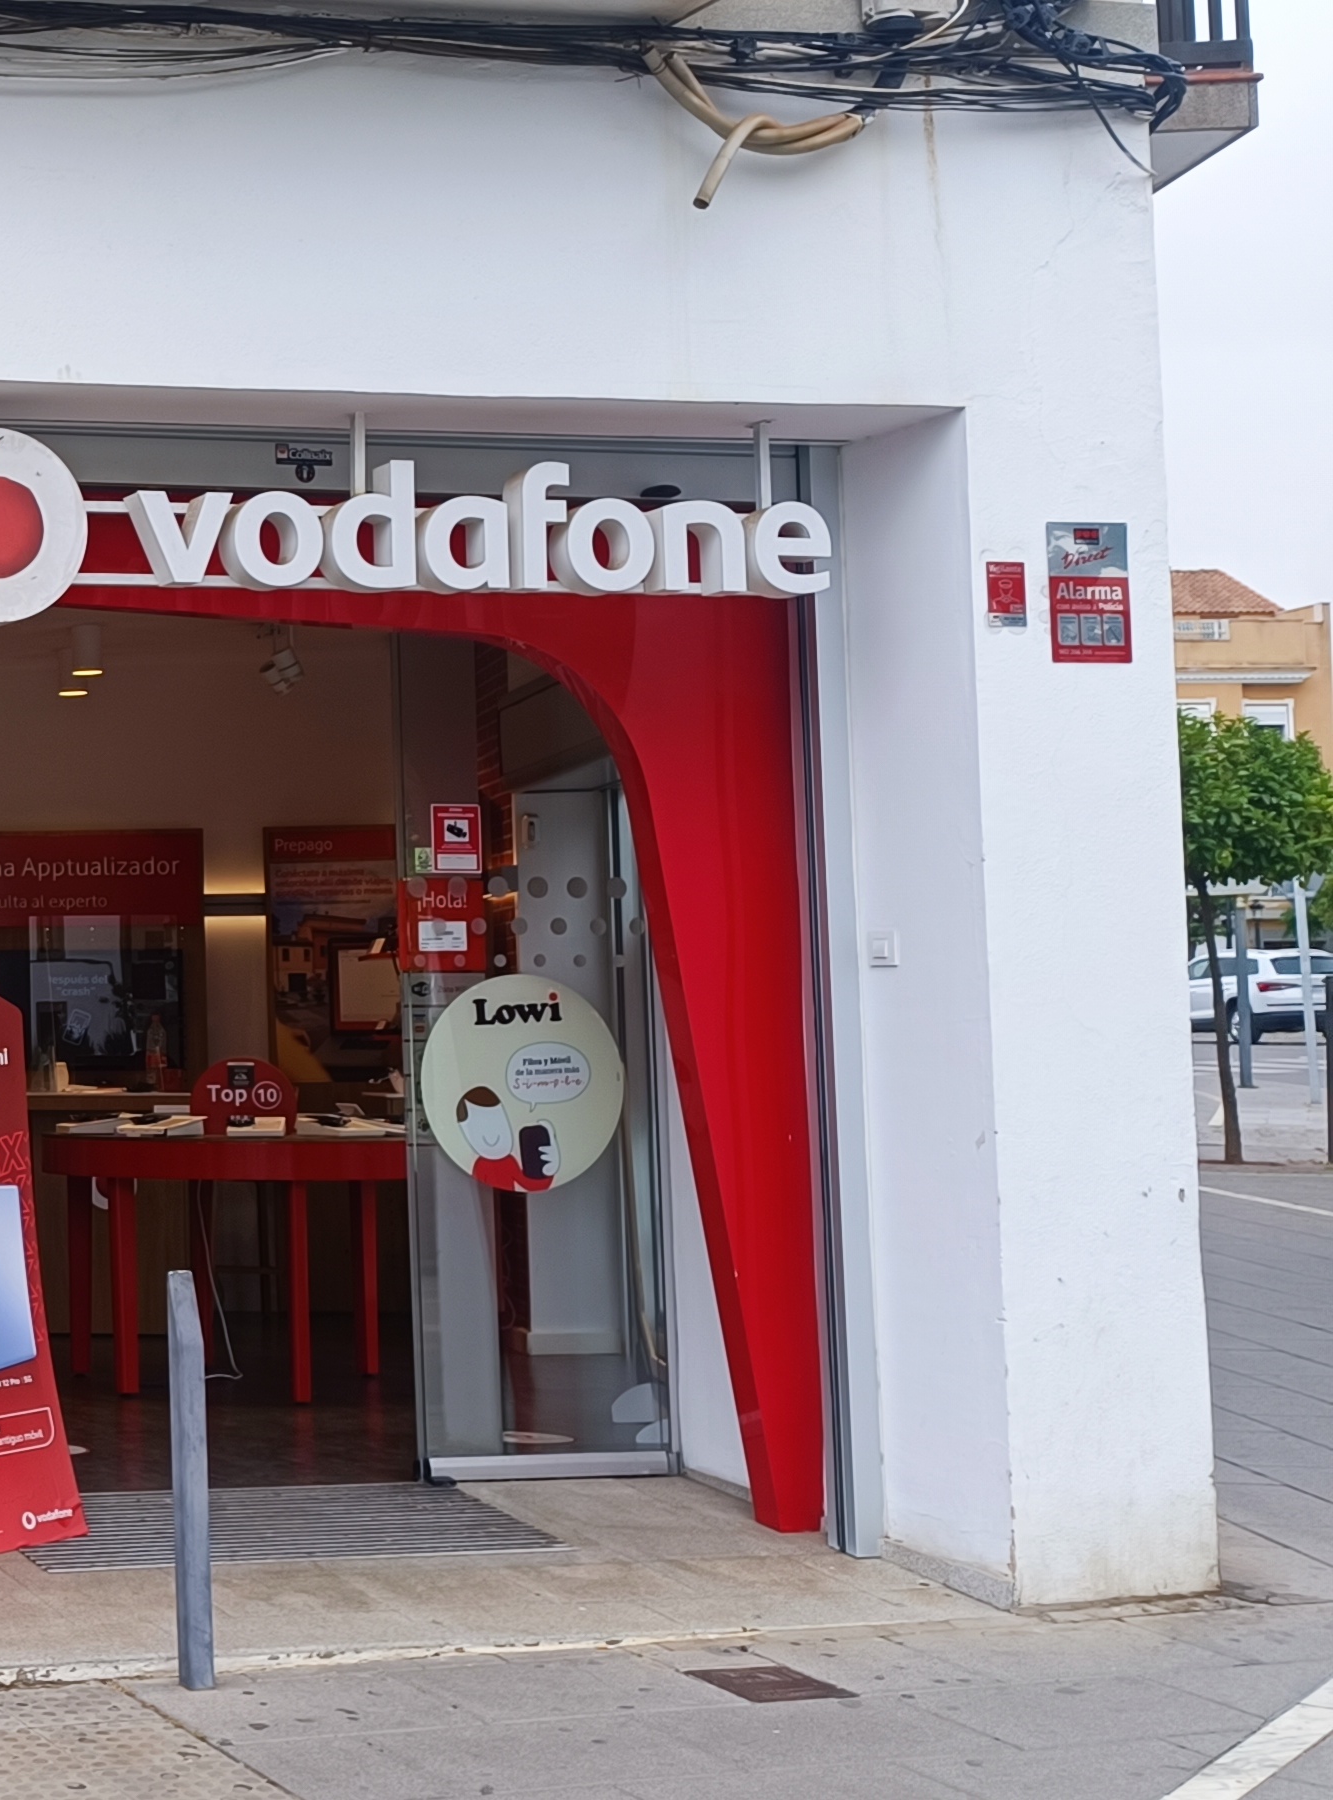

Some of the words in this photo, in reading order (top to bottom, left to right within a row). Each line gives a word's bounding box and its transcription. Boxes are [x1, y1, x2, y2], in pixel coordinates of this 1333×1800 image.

[123, 460, 833, 599] vodafone
[1056, 581, 1123, 600] Alarma
[274, 838, 333, 854] Prepago
[21, 856, 180, 881] Apptualizador
[31, 895, 45, 908] al
[49, 895, 108, 910] experto
[91, 974, 109, 984] del
[472, 992, 562, 1025] Lowi
[206, 1084, 248, 1106] Top
[257, 1088, 278, 1102] 10
